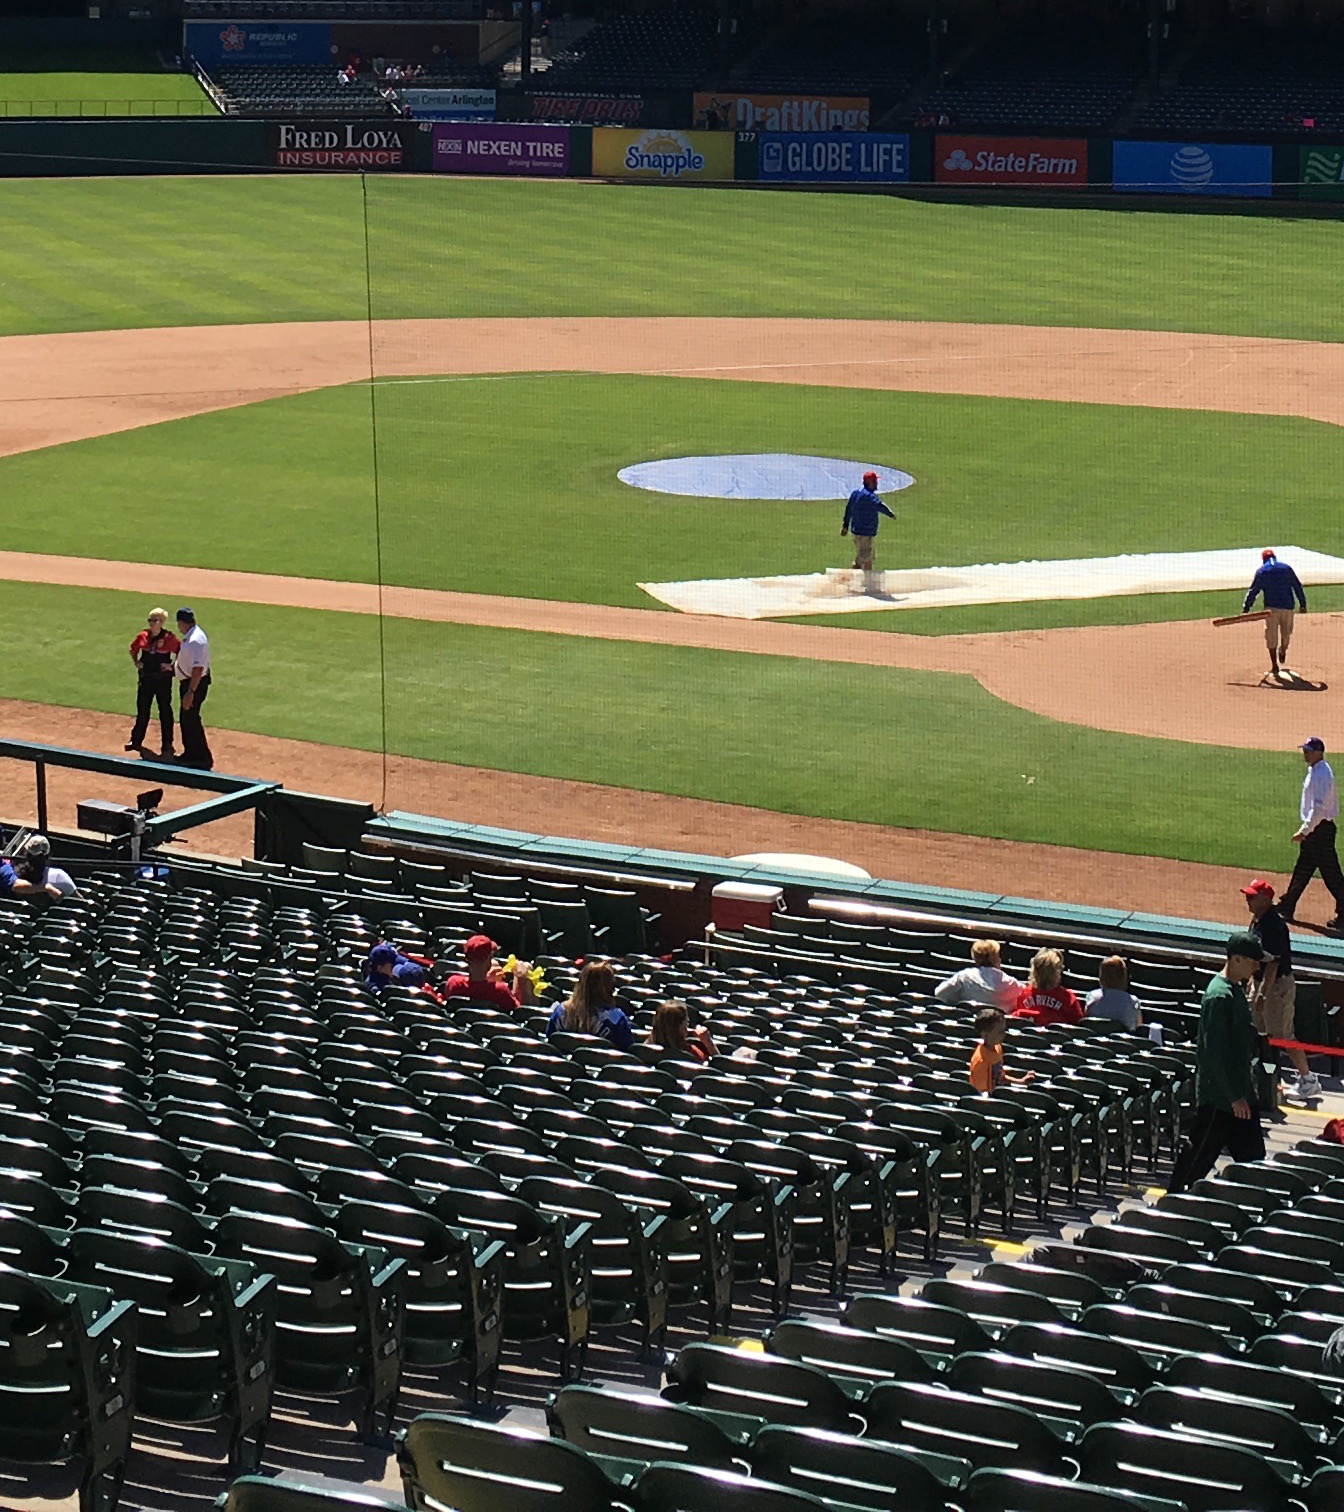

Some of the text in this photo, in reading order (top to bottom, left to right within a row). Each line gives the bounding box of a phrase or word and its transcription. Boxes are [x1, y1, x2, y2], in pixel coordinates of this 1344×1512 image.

[248, 32, 298, 42] REPUBLIC
[421, 94, 495, 107] Center Arlington
[532, 96, 646, 121] TIRE PROS
[737, 98, 869, 133] DraftKings
[279, 124, 403, 148] FRED LOYA
[738, 132, 756, 143] 377
[279, 150, 403, 166] INSURANCE
[467, 140, 565, 158] NEXEN TIRE
[787, 142, 905, 174] GLOBE LIFE
[625, 146, 703, 176] Snapple
[1022, 994, 1063, 1010] DARVISH
